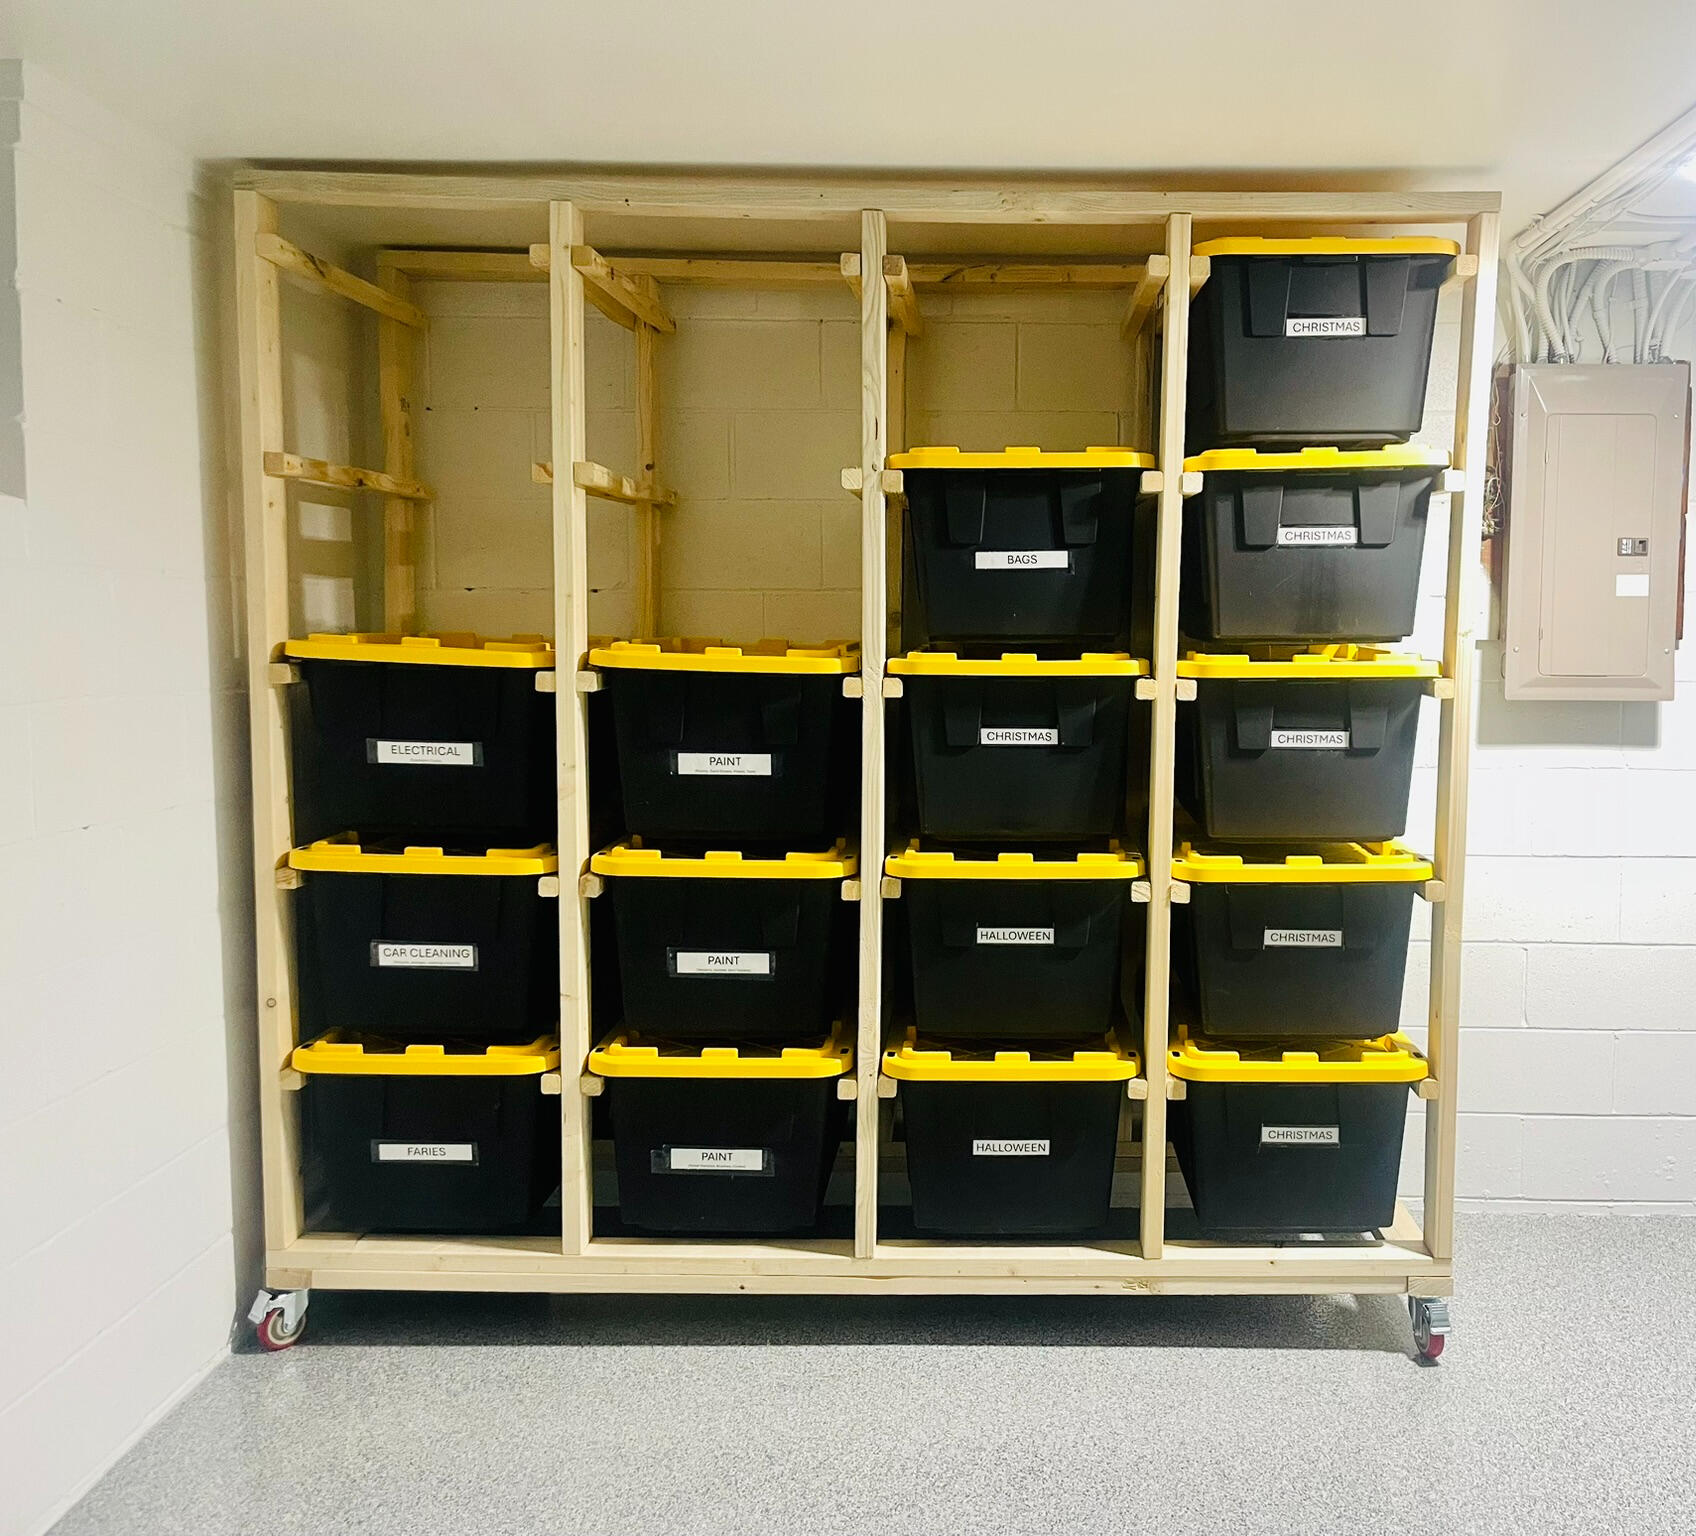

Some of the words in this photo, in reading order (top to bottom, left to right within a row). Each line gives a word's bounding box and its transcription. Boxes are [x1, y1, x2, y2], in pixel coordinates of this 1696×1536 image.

[1292, 321, 1361, 333] CHRISTMAS
[1284, 530, 1352, 542] CHRISTMAS
[1006, 554, 1039, 566] BAGS
[986, 730, 1053, 742] CHRISTMAS
[1277, 733, 1344, 745] CHRISTMAS
[390, 744, 461, 757] ELECTRICAL
[708, 756, 742, 767] PAINT
[979, 930, 1052, 942] HALLOWEEN
[1269, 932, 1337, 944] CHRISTMAS
[382, 947, 408, 958] CAR
[409, 947, 471, 959] CLEANING
[707, 955, 741, 966] PAINT
[1267, 1129, 1334, 1141] CHRISTMAS
[406, 1146, 448, 1158] FARIES
[975, 1142, 1047, 1153] HALLOWEEN
[700, 1151, 735, 1162] PAINT
